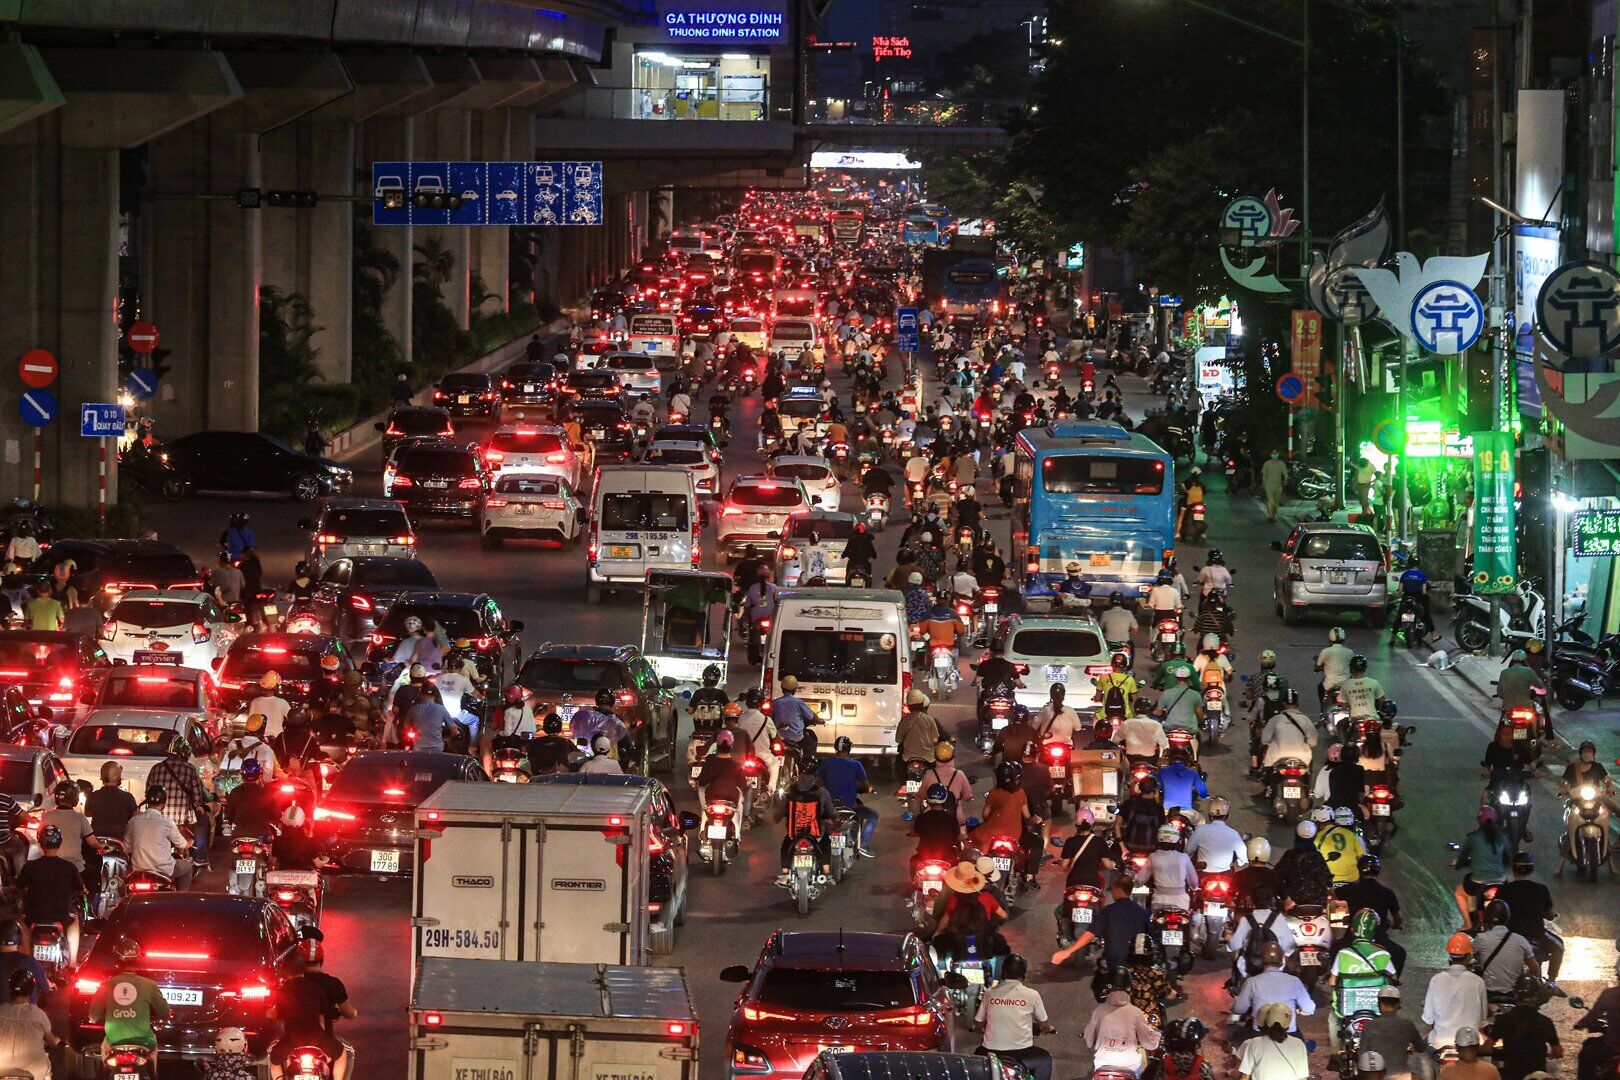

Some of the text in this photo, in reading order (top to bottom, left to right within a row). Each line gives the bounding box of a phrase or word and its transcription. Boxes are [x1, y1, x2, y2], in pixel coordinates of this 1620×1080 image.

[666, 13, 686, 24] GA
[688, 13, 748, 27] THƯỢNG
[669, 28, 780, 37] THUONG DINH STATION
[872, 36, 909, 46] Nhà Sách
[1331, 832, 1346, 852] 9
[456, 878, 603, 889] THACO FRONTIER
[425, 928, 499, 949] 29H-584.50
[990, 998, 1027, 1007] CONINCO
[113, 1008, 137, 1018] Grab
[455, 1068, 469, 1080] XE
[493, 1065, 514, 1080] BÁO
